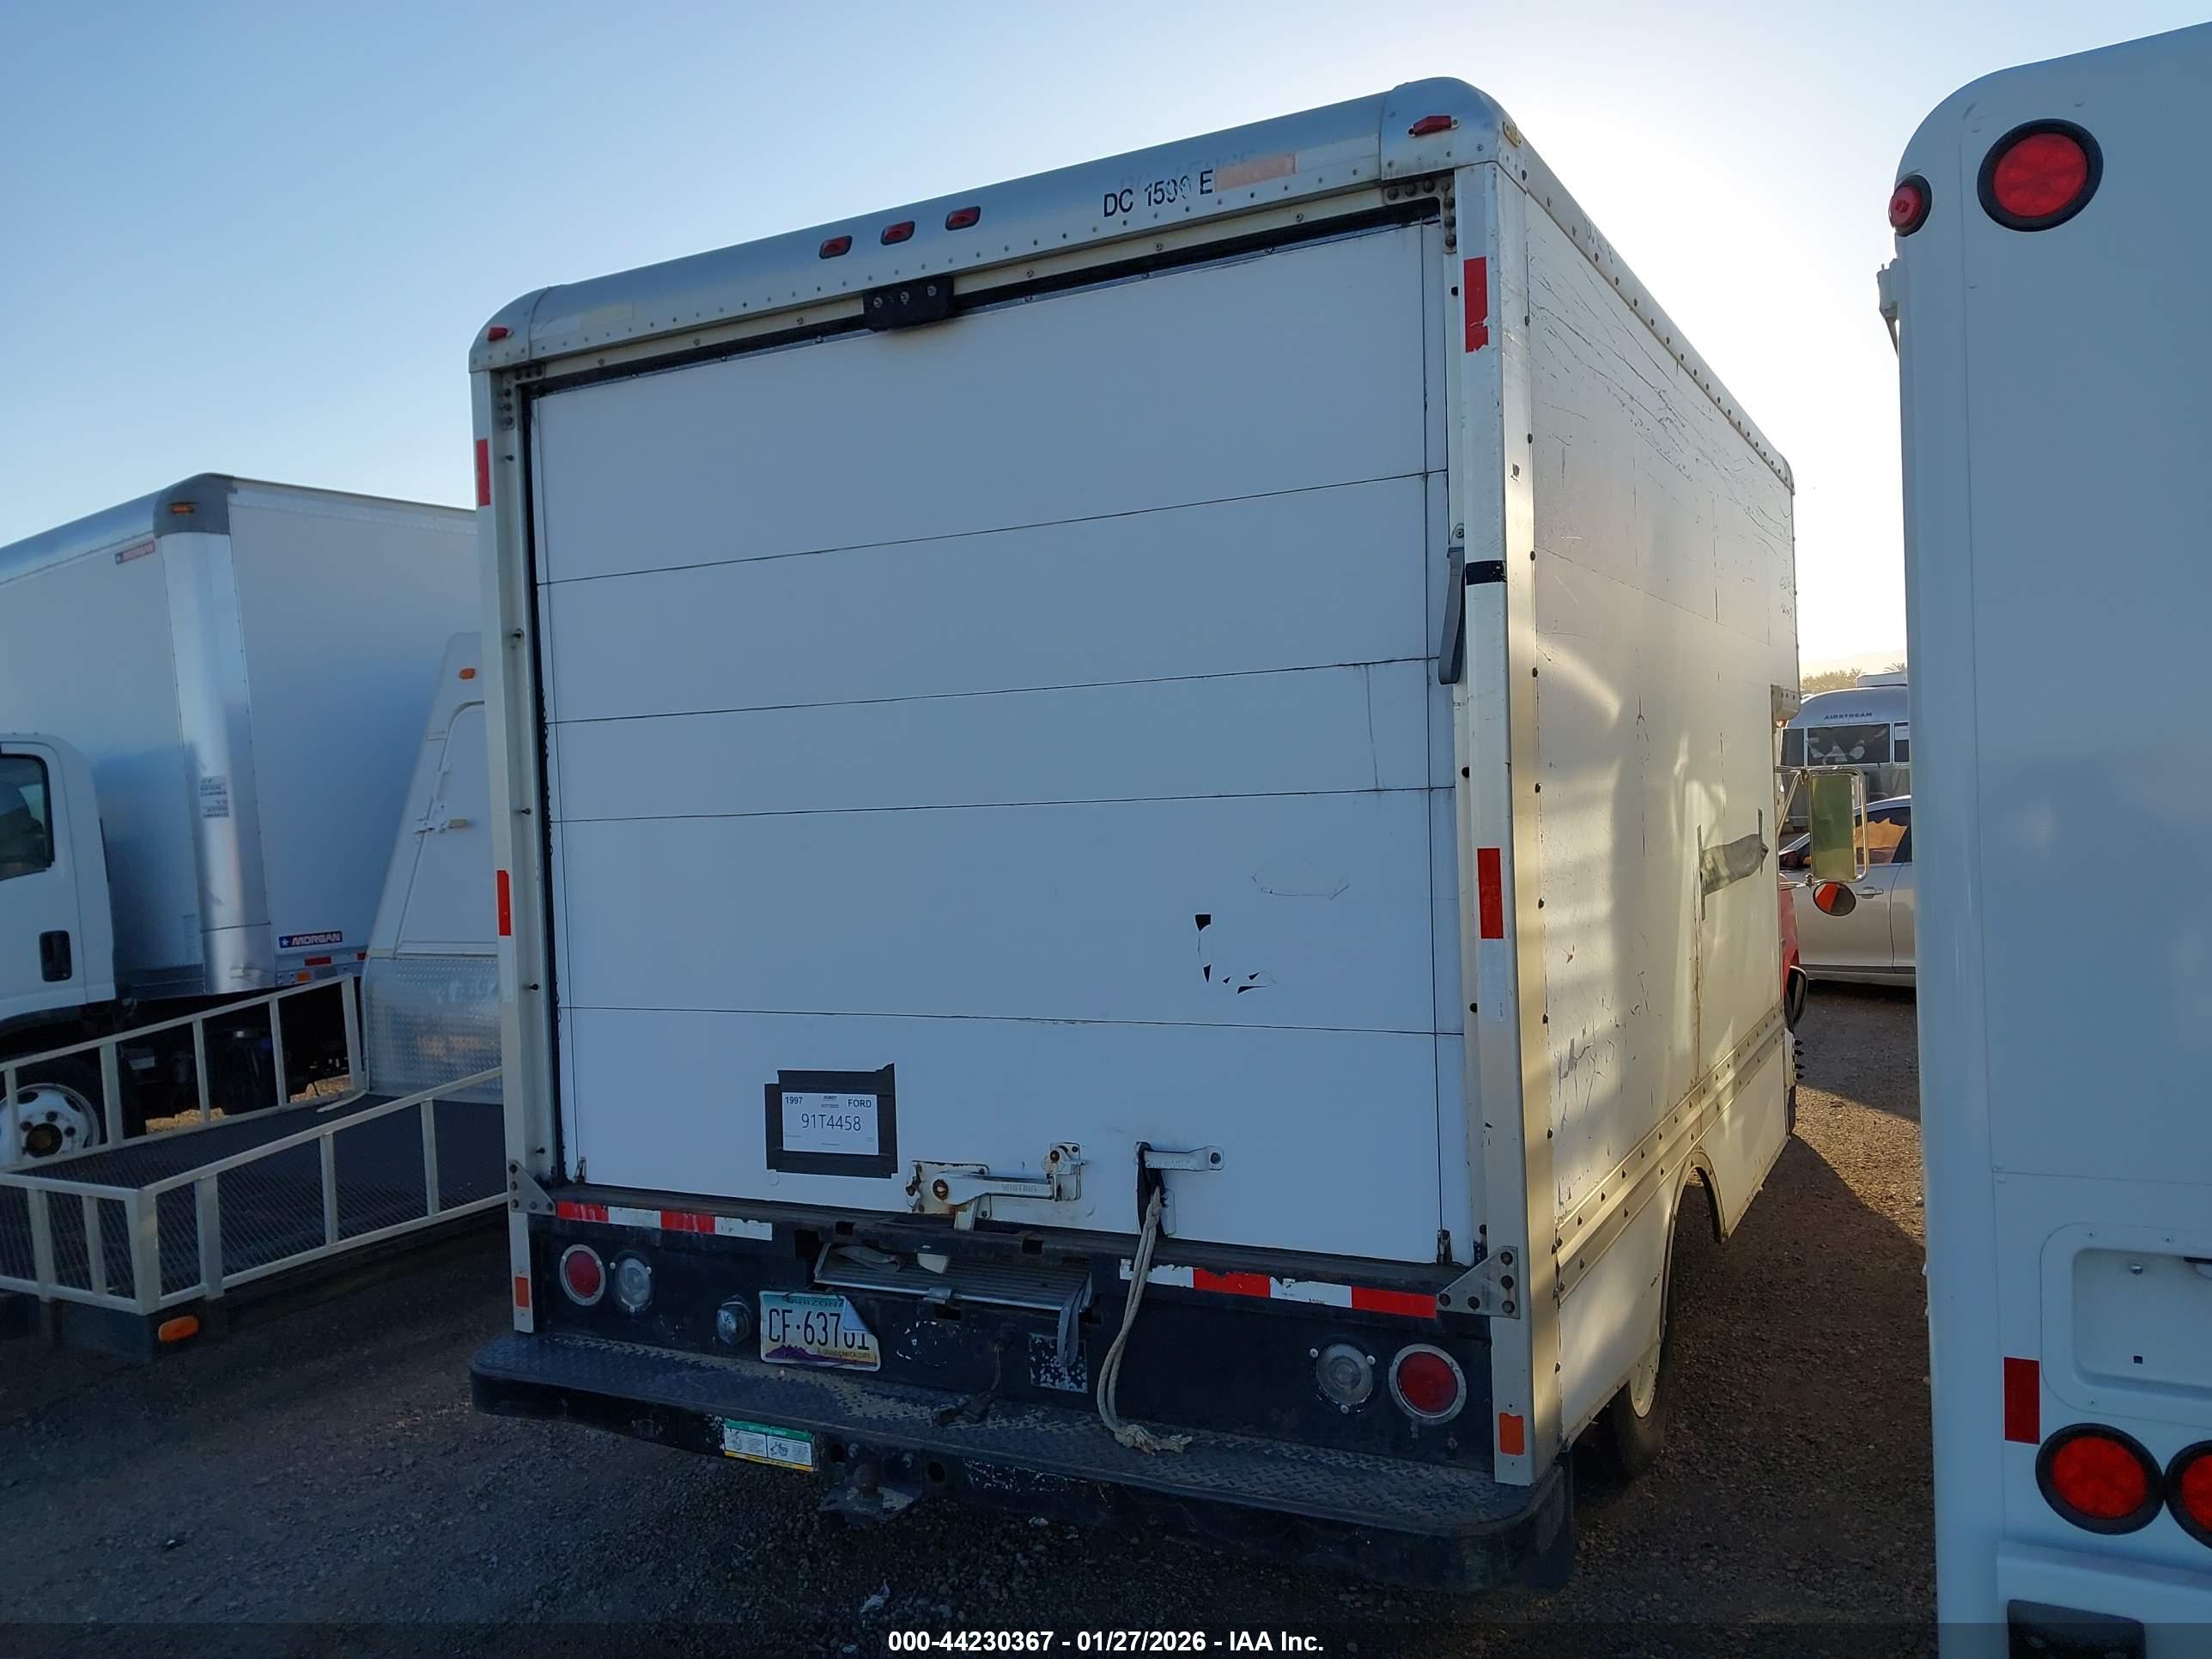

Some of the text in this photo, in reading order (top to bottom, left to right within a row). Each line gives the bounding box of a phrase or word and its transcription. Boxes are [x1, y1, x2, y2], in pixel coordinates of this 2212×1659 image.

[1103, 188, 1133, 217] DC
[1200, 169, 1213, 196] E
[1824, 712, 1873, 720] AIRSTREAM
[292, 933, 341, 945] MORGAN
[785, 1096, 804, 1105] 1997
[848, 1098, 872, 1109] FORD
[801, 1113, 861, 1132] 91T4458
[792, 1297, 844, 1308] ARIZONA
